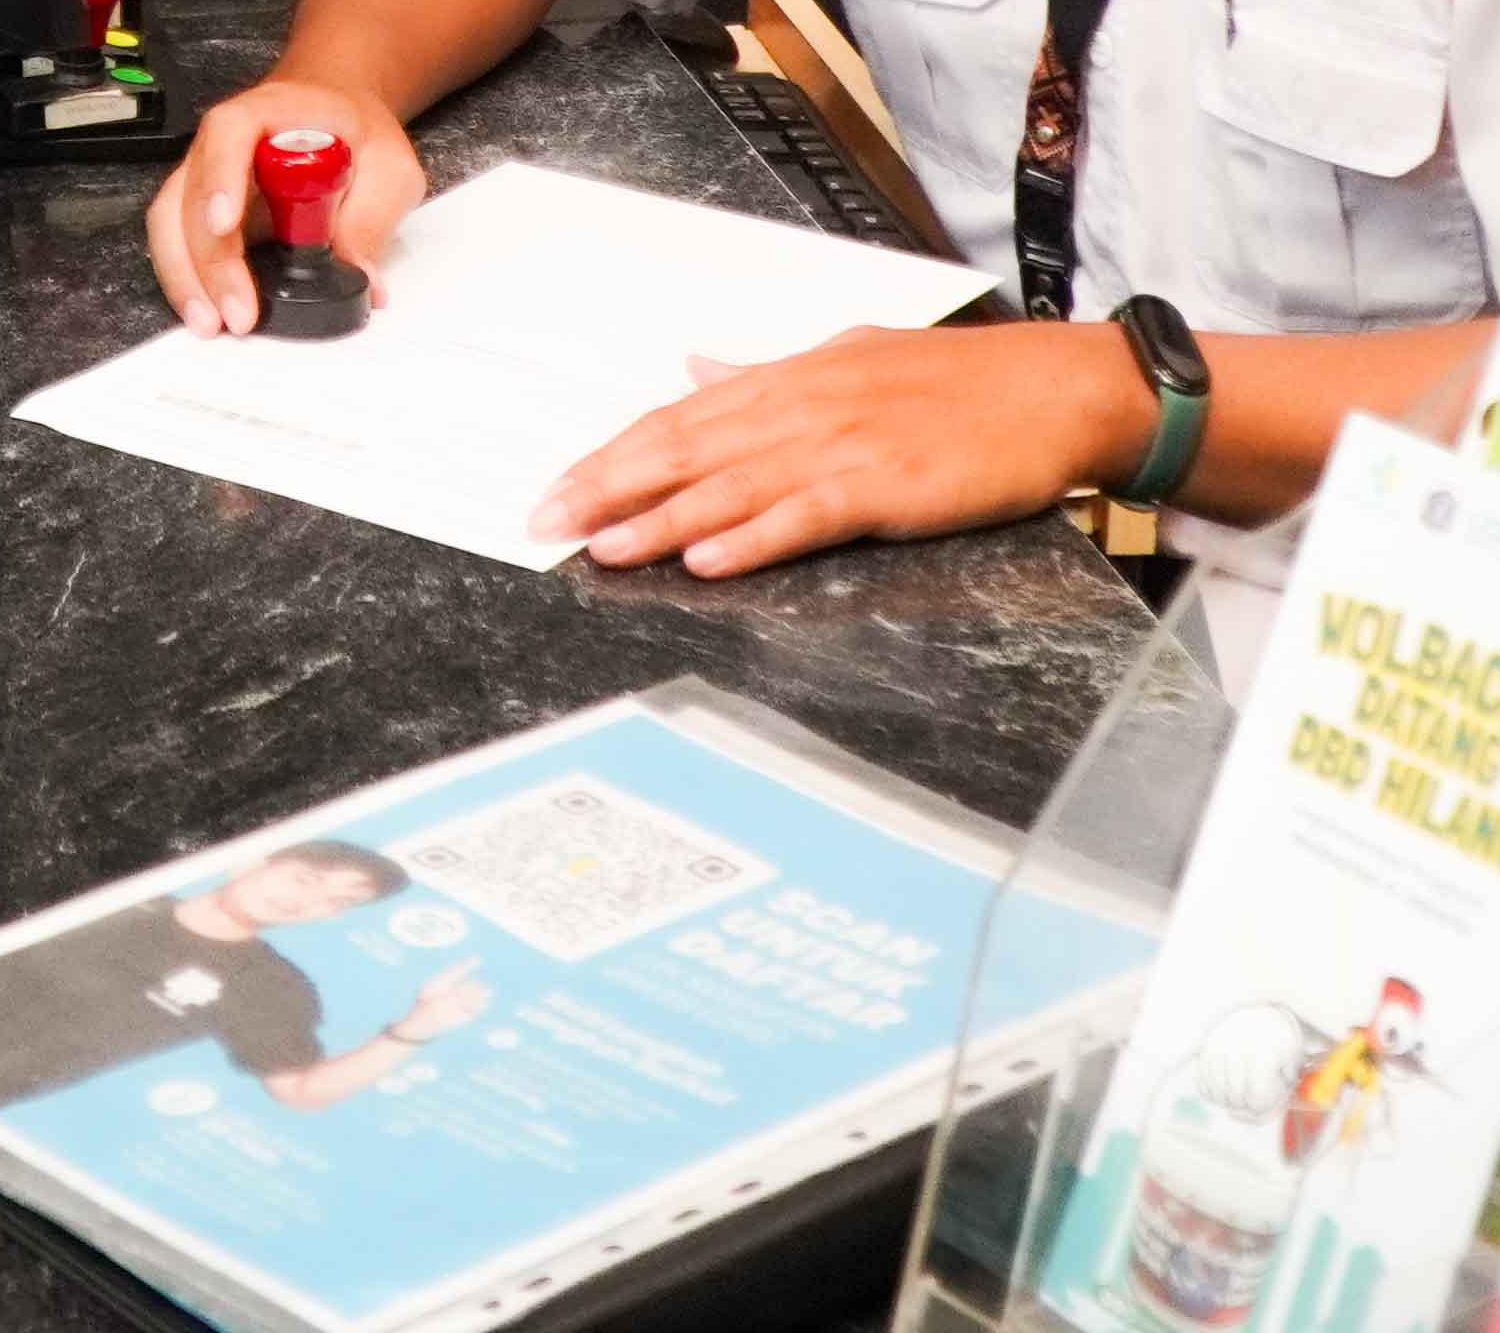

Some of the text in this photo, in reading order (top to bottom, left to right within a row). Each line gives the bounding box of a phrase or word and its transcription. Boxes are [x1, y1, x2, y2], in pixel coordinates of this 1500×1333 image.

[1288, 713, 1374, 793] DBD
[721, 909, 930, 998] UNTUK
[768, 887, 941, 967] SCAN
[667, 930, 910, 1031] DAFTAR
